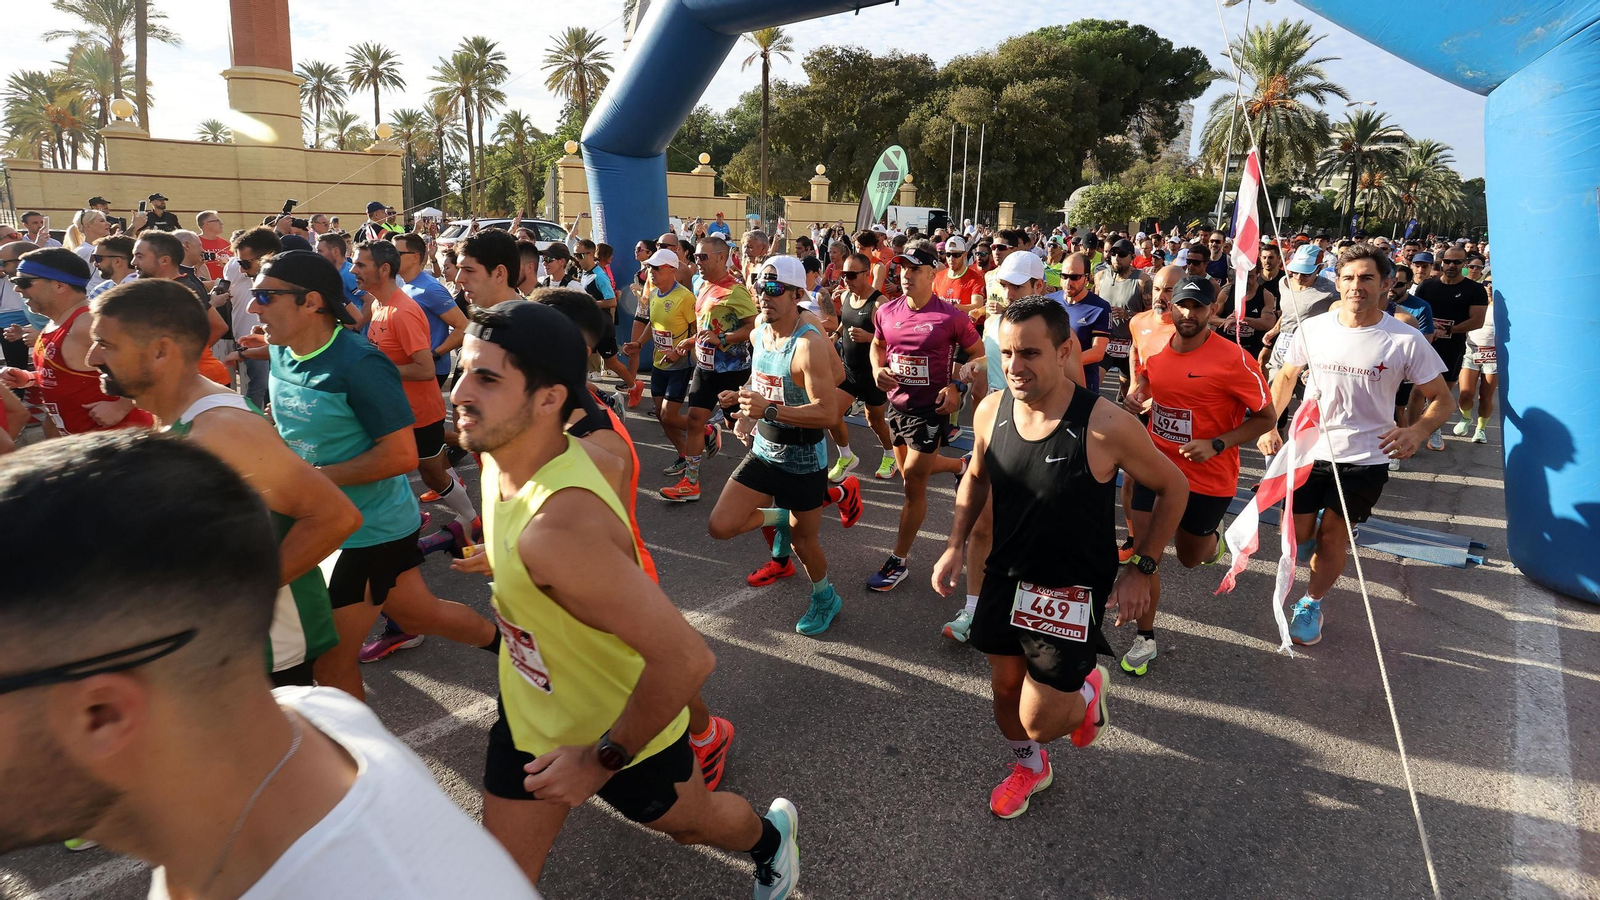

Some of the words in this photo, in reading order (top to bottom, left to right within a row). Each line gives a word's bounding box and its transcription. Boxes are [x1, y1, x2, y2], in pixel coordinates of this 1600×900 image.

[899, 365, 918, 376] 583
[1314, 363, 1376, 376] MONTESIERRA
[1158, 416, 1179, 431] 494
[1030, 596, 1070, 620] 469
